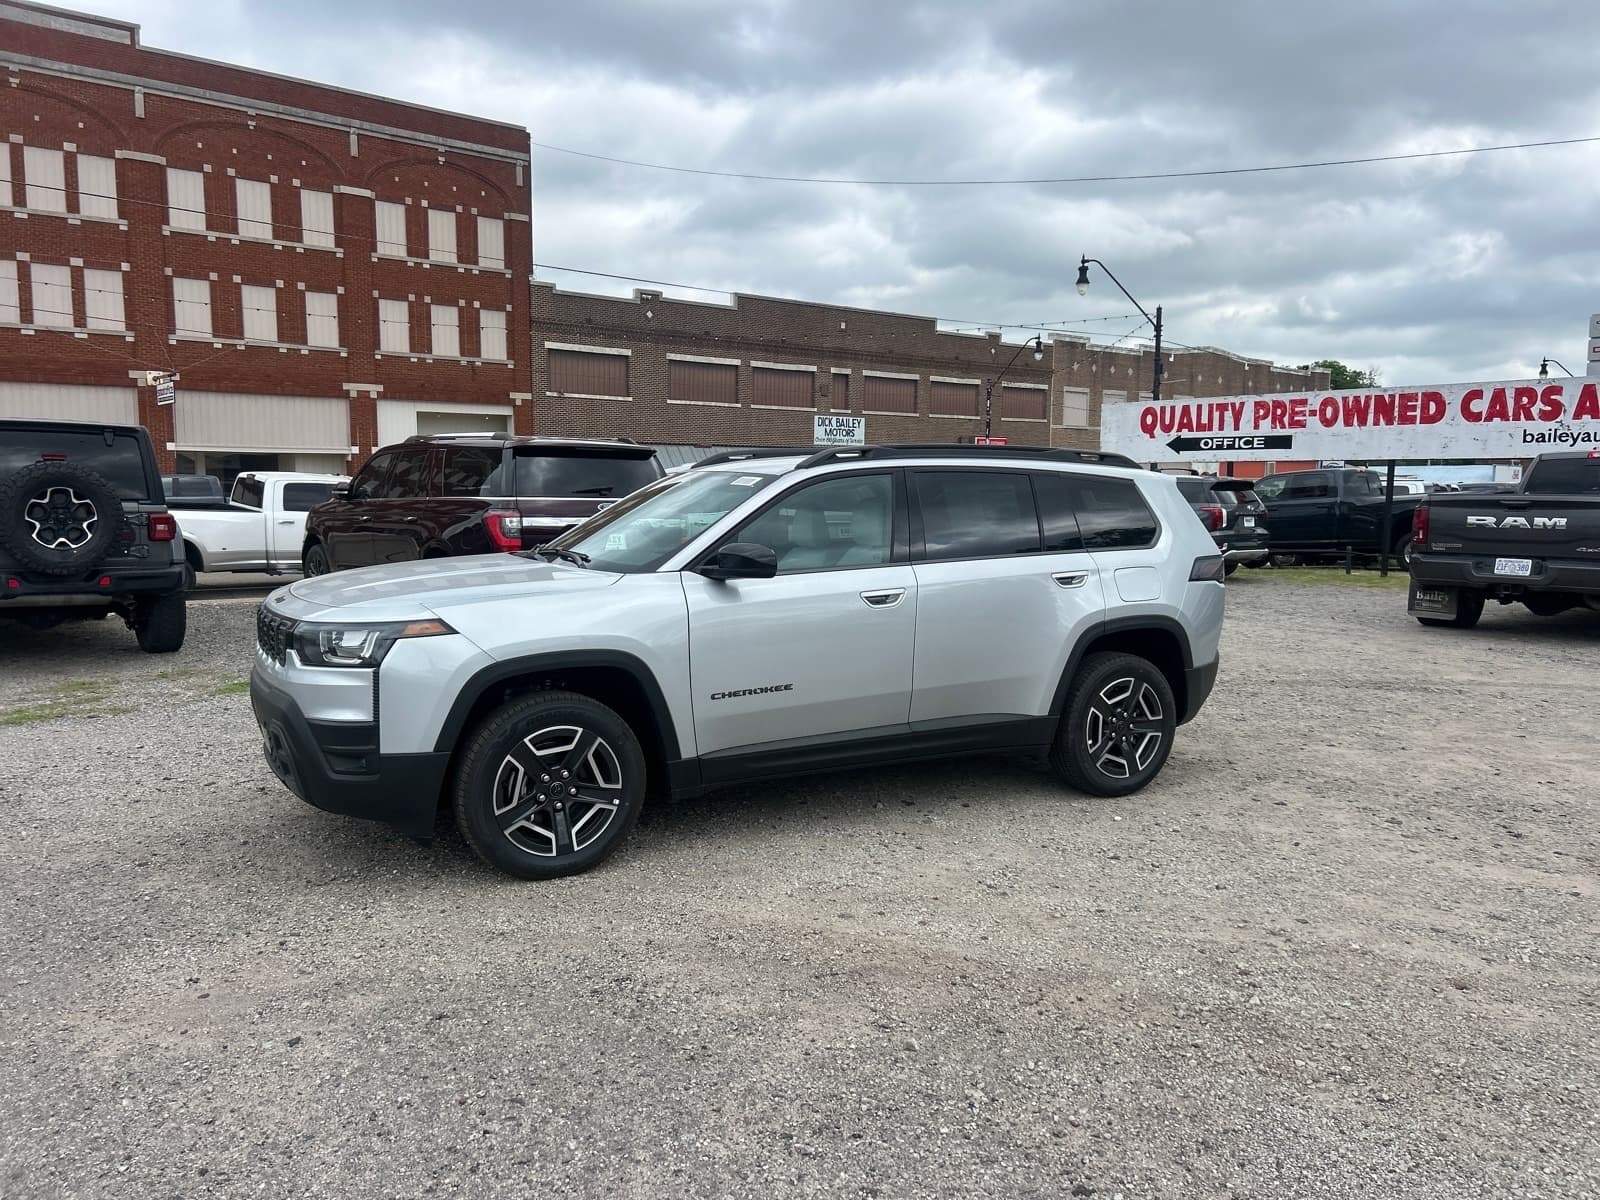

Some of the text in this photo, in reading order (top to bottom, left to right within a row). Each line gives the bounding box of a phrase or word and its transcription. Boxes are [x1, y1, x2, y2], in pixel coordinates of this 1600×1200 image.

[1140, 402, 1245, 439] QUALITY
[1252, 391, 1447, 430] PRE-OWNED
[1460, 384, 1564, 423] CARS
[817, 416, 861, 428] DICK BAILEY
[824, 427, 855, 437] MOTORS
[1199, 437, 1265, 450] OFFICE
[1466, 516, 1568, 529] RAM
[710, 683, 794, 700] CHEROKEE
